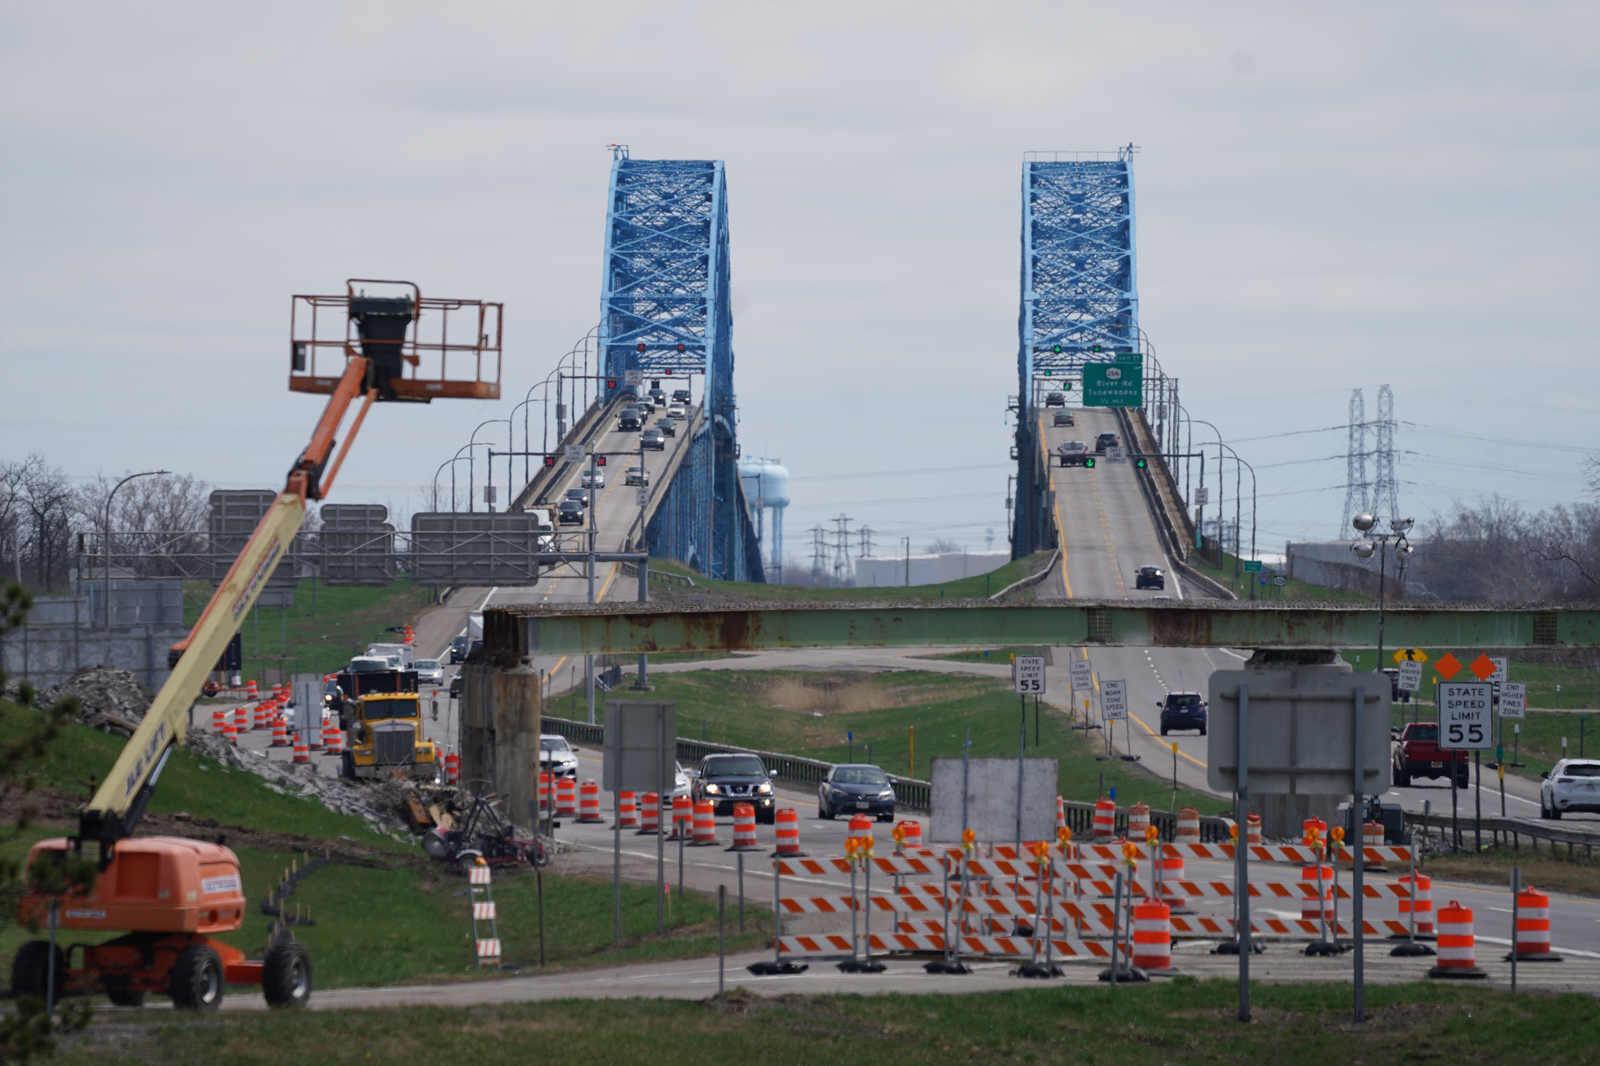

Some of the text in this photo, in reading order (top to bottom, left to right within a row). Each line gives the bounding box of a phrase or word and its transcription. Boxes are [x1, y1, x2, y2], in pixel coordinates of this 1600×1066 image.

[1020, 680, 1040, 691] 55
[1448, 688, 1484, 697] STATE
[1447, 699, 1485, 709] SPEED
[1451, 711, 1482, 721] LIMIT
[1448, 724, 1484, 743] 55
